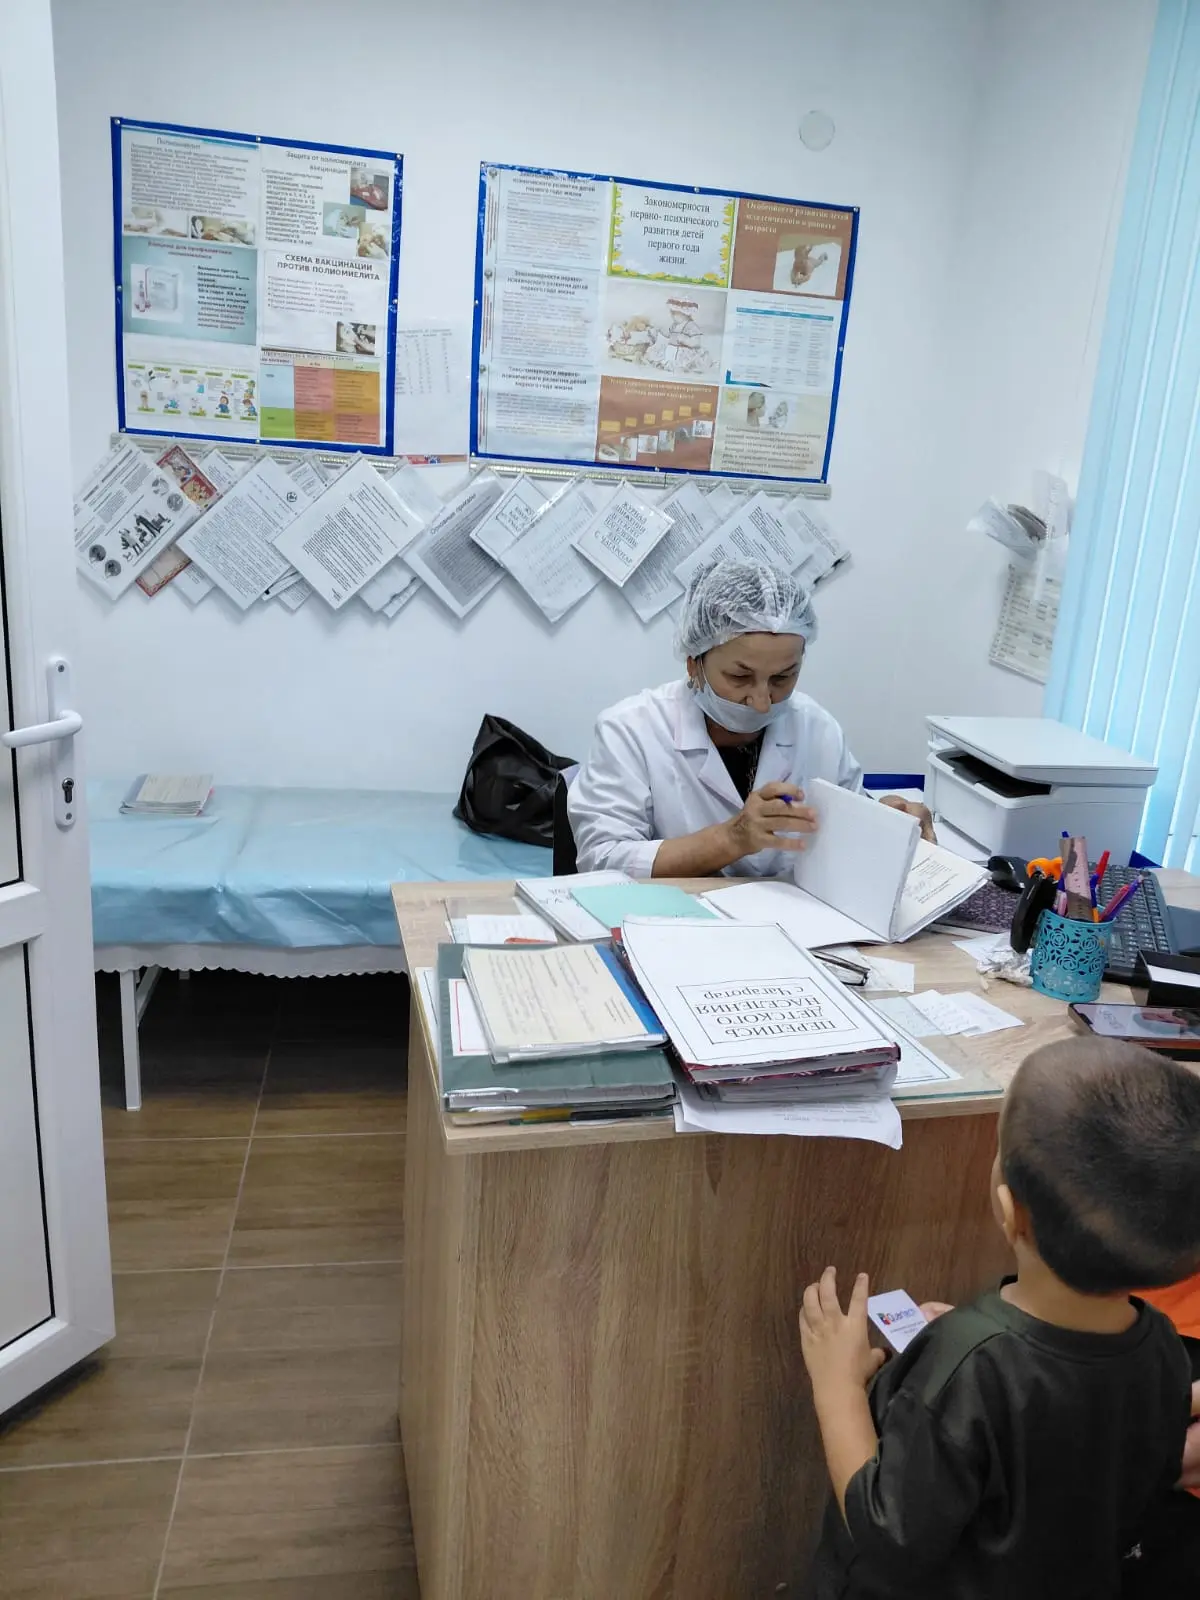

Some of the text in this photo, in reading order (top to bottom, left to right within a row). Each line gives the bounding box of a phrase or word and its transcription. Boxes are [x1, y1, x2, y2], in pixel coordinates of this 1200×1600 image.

[286, 150, 310, 161] Защита
[321, 156, 367, 168] полиомиелита
[644, 195, 710, 213] Закономерности
[630, 210, 719, 228] нервно- психического
[643, 225, 704, 240] развития детей
[648, 240, 700, 253] первого года
[285, 254, 373, 271] СХЕМА ВАКЦИНАЦИИ
[659, 254, 687, 265] жизни.
[277, 262, 380, 281] ПРОТИВ ПОЛИОМИЕЛИТА
[704, 985, 792, 1001] Чагаротар
[695, 996, 821, 1014] НАСЕЛЕНИЯ
[716, 1005, 824, 1025] ДЕТСКОГО
[724, 1020, 836, 1038] ПЕРЕПИСЬ
